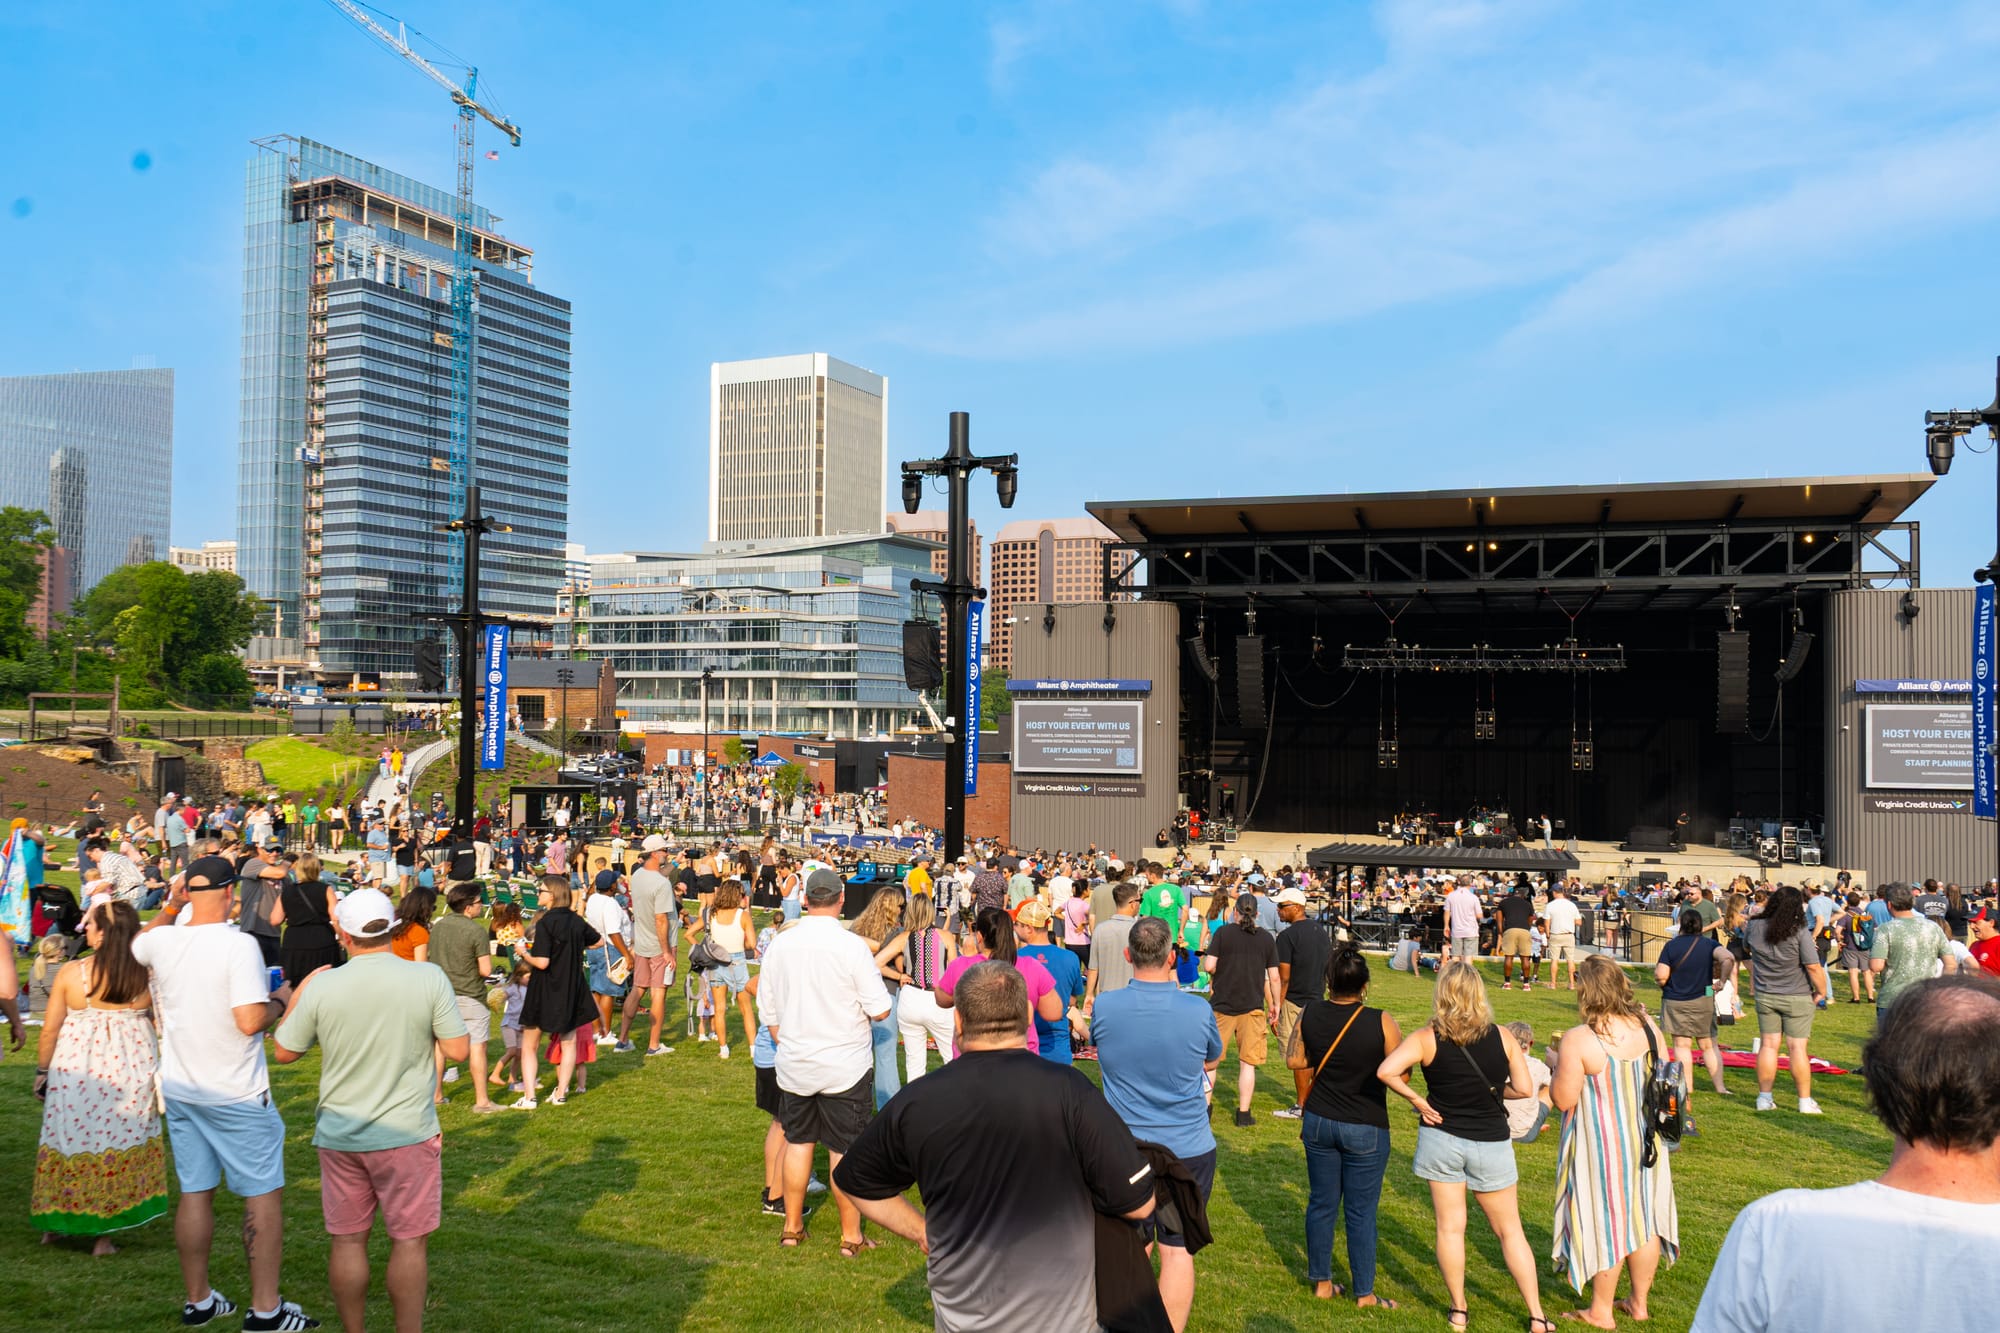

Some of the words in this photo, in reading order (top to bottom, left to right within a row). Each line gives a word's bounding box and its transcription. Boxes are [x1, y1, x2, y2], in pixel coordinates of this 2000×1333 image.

[1978, 598, 1991, 656] Allianz
[970, 612, 980, 660] Allianz
[491, 632, 503, 669] Allianz
[1036, 681, 1060, 689] Allianz
[1069, 681, 1120, 690] Amphitheater
[1897, 682, 1929, 690] Allianz
[488, 685, 501, 762] Amphitheater
[1025, 721, 1047, 729] HOST
[1048, 721, 1070, 730] YOUR
[1071, 722, 1095, 730] EVENT
[1096, 722, 1119, 731] WITH
[1119, 722, 1131, 731] US
[966, 683, 977, 784] Amphitheater
[1882, 729, 1911, 738] HOST
[1912, 729, 1941, 738] YOUR
[1976, 684, 1989, 805] Amphitheater
[1905, 759, 1930, 767] START
[1025, 784, 1046, 792] Virginia
[1875, 801, 1903, 809] Virginia
